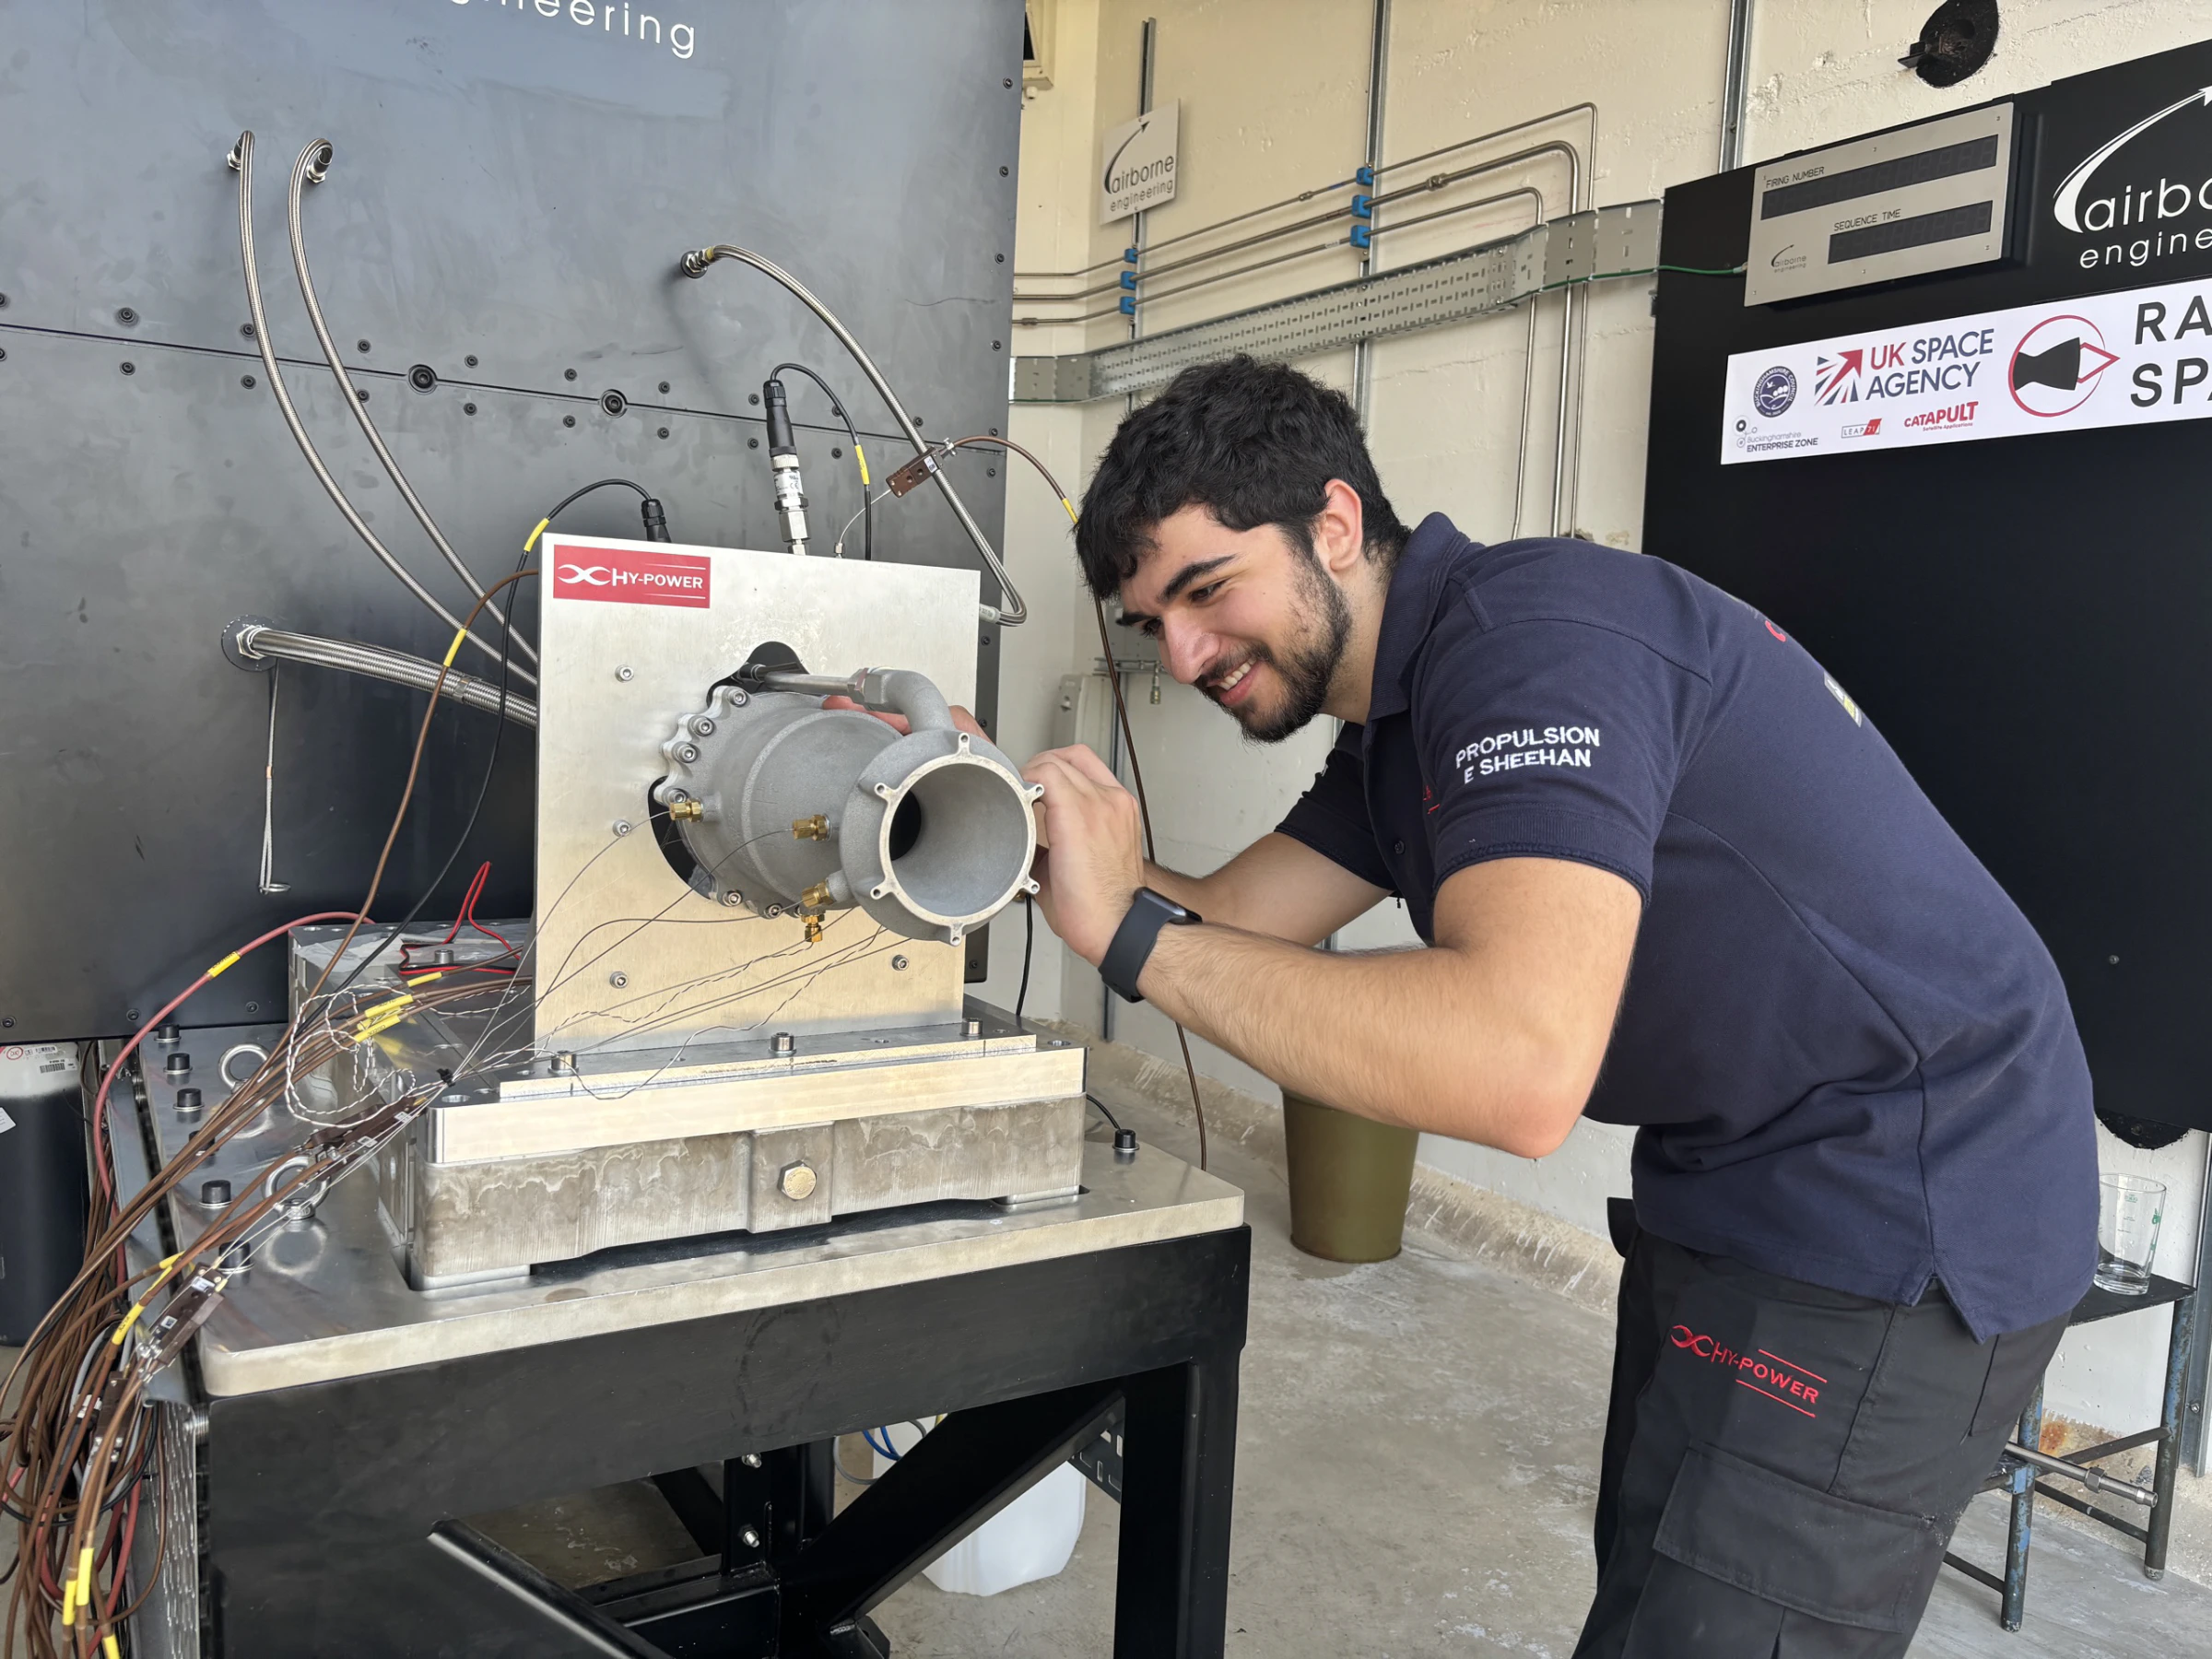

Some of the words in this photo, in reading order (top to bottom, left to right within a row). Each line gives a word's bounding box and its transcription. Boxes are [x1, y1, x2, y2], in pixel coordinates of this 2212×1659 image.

[1112, 155, 1174, 194] airborne
[1765, 175, 1790, 188] FIRING
[1792, 167, 1825, 182] NUMBER
[1110, 180, 1174, 212] engineering
[1833, 214, 1878, 231] SEQUENCE
[1882, 209, 1901, 219] TIME
[1774, 255, 1806, 267] airborne
[1870, 341, 1907, 371] UK
[1912, 328, 1994, 365] SPACE
[1865, 361, 1981, 401] AGENCY
[2130, 357, 2212, 407] SP
[1904, 401, 1979, 428] CATAPULT
[1747, 431, 1802, 443] Buckinghamshire
[1747, 441, 1794, 453] ENTERPRISE
[1794, 438, 1818, 448] ZONE
[1843, 427, 1864, 436] LEAP
[612, 568, 703, 589] HY-POWER
[1455, 726, 1600, 769] PROPULSION
[1465, 766, 1475, 784] E
[1480, 748, 1591, 775] SHEEHAN
[1711, 1341, 1819, 1404] HY-POWER
